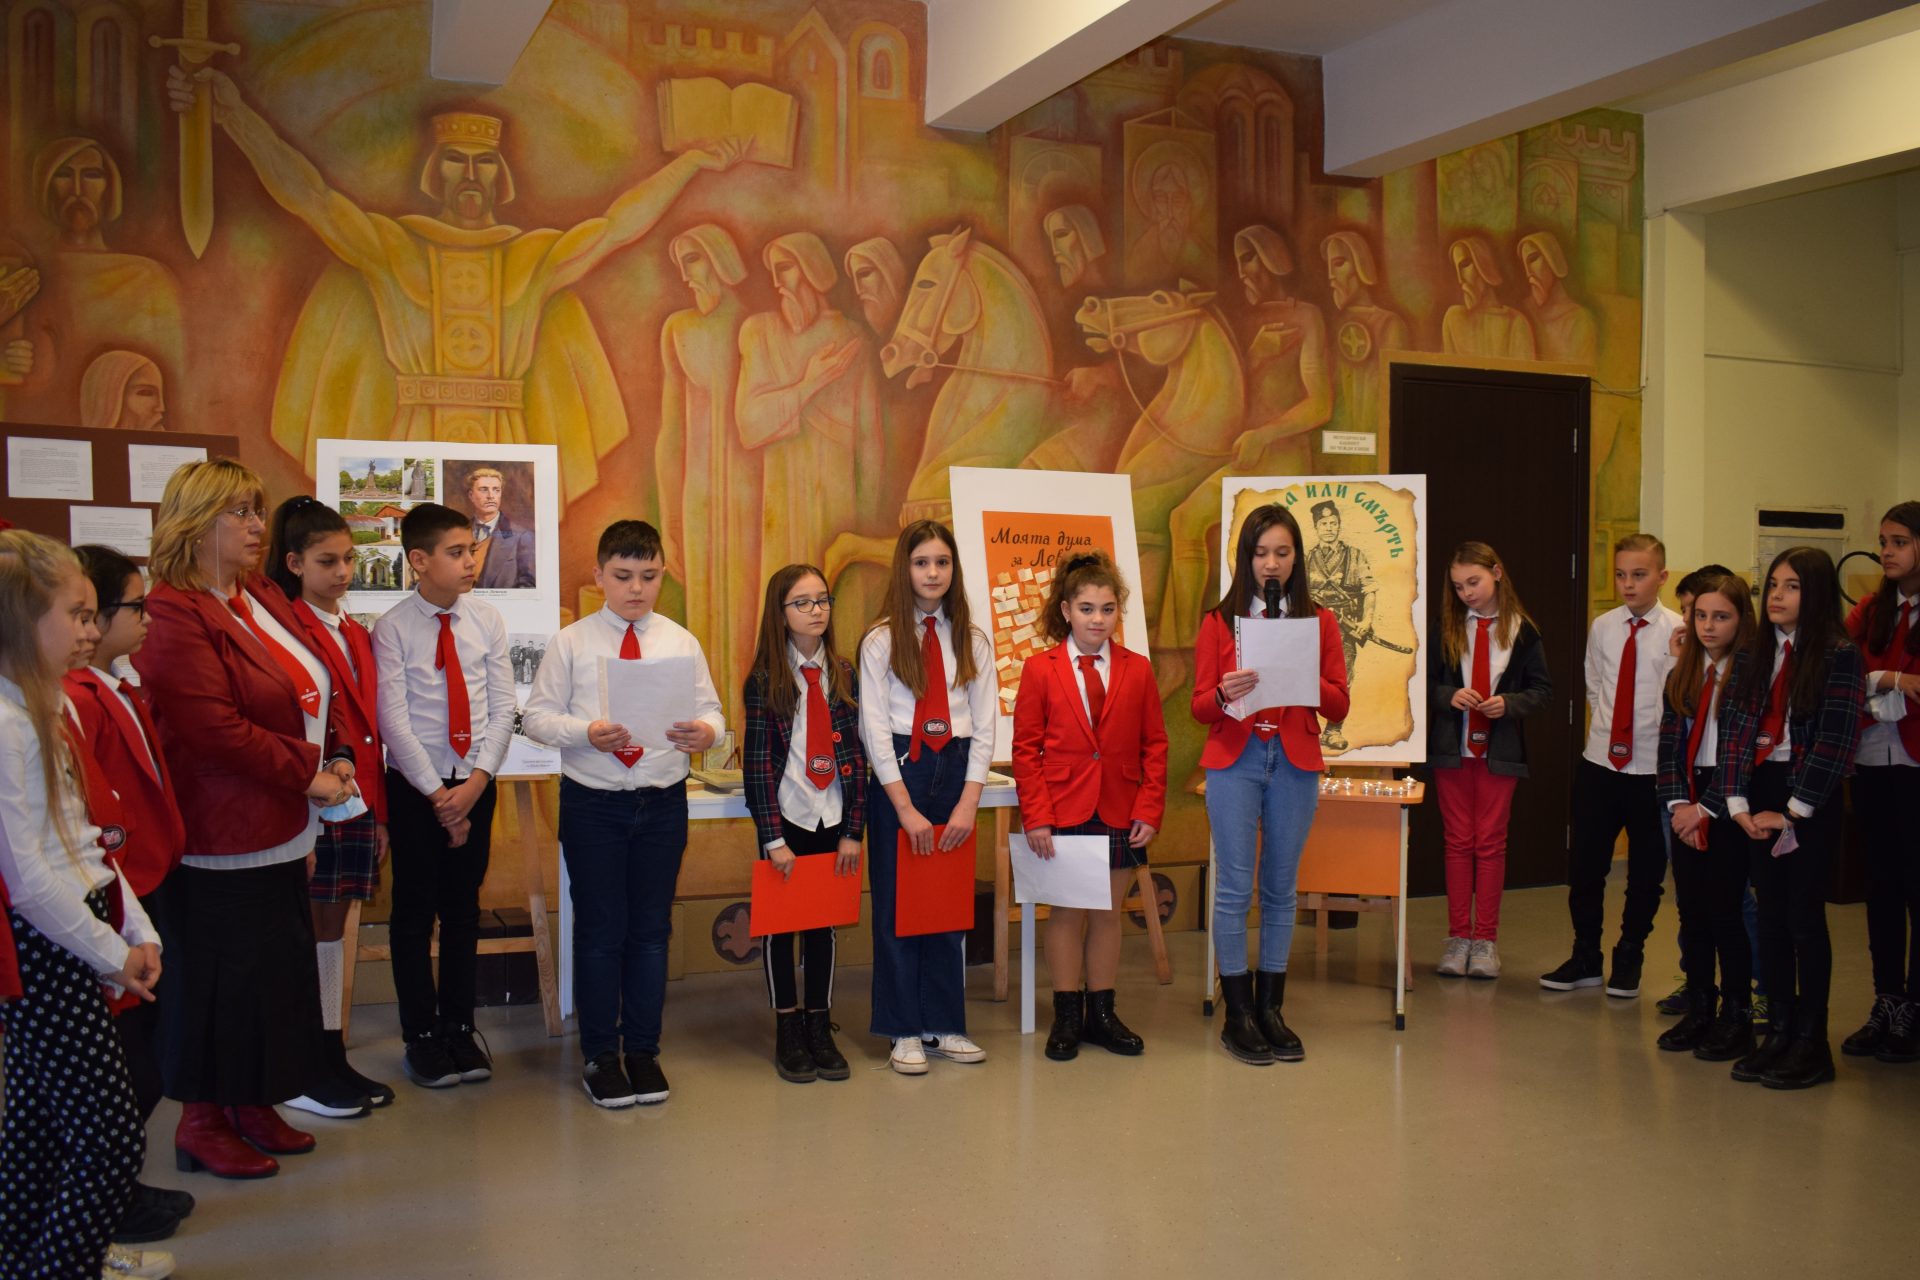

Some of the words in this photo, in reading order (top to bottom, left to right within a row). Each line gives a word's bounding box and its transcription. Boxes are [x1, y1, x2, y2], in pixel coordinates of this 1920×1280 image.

[991, 527, 1051, 546] Моята
[1057, 530, 1092, 552] дума
[1010, 556, 1023, 568] за
